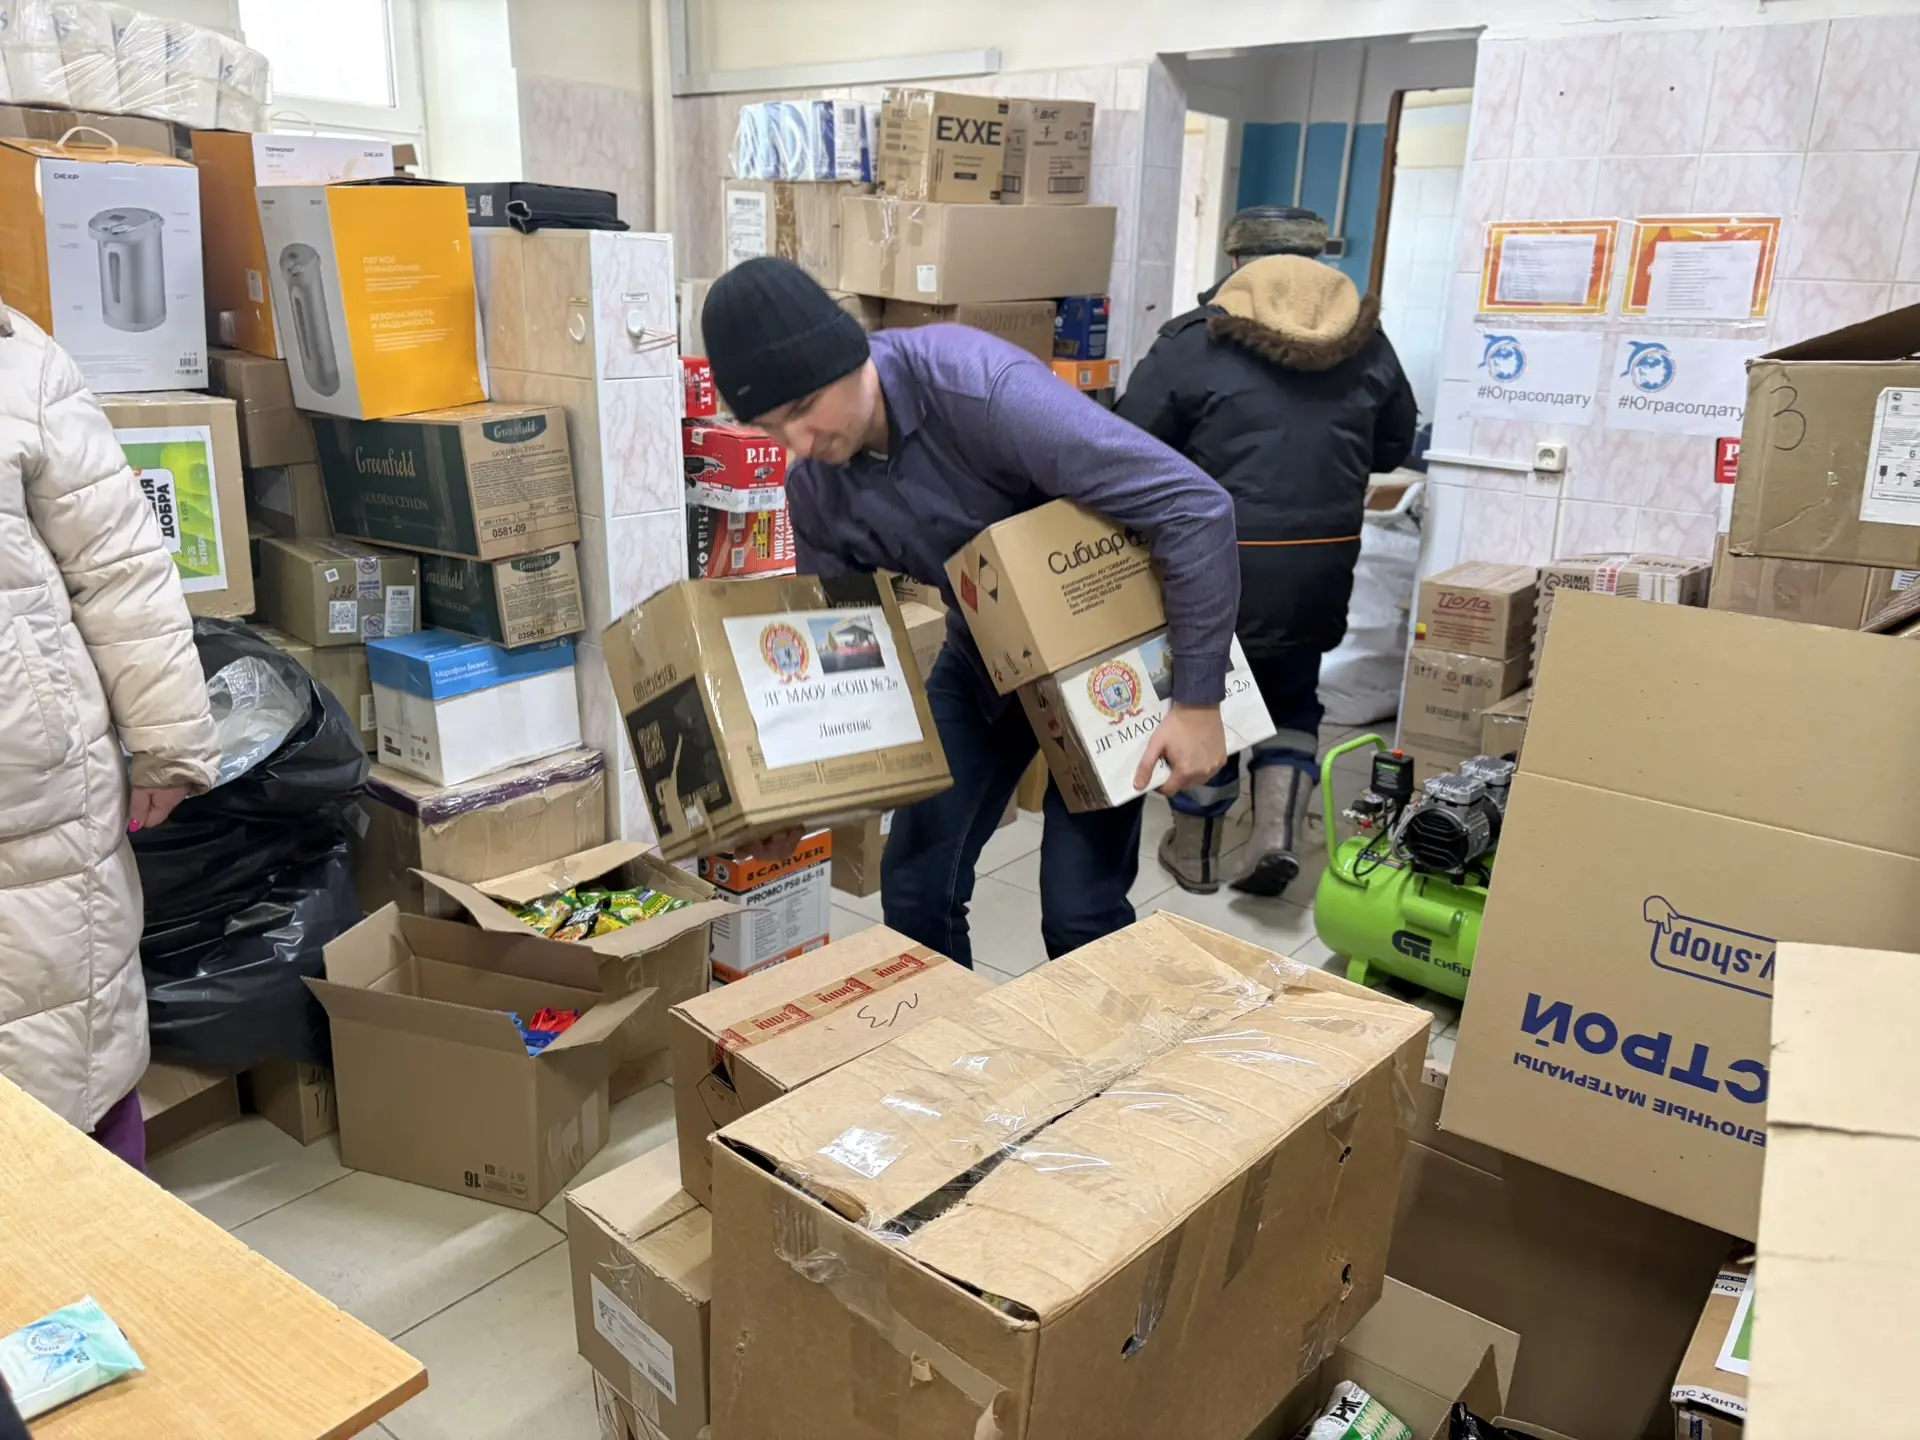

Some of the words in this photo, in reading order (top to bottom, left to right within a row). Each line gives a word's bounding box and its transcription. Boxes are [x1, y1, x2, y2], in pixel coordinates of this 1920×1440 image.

[936, 116, 1003, 146] EXXE
[699, 366, 711, 409] P.I.T.
[1477, 385, 1591, 409] #Юграсолдату
[1618, 395, 1744, 421] #Юграсолдату
[1770, 385, 1806, 451] 3
[493, 420, 536, 438] Greenfield
[355, 446, 416, 479] Greenfield
[746, 447, 782, 464] P.I.T.
[156, 483, 176, 539] ДОБРА
[492, 523, 526, 538] 0581-09
[1048, 533, 1124, 575] Сибиар
[1562, 574, 1590, 584] SIMA
[435, 665, 466, 678] Марафон
[764, 690, 782, 708] ЛГ
[786, 684, 826, 703] МАОУ
[831, 680, 868, 699] «СОШ
[886, 675, 898, 691] 2»
[1232, 679, 1251, 693] 2»
[819, 718, 873, 739] Лангепас
[1095, 733, 1116, 754] ЛГ
[1117, 712, 1163, 744] МАОУ
[756, 845, 825, 877] CARVER
[746, 886, 783, 906] PROMO
[1669, 927, 1775, 981] y.shop
[876, 960, 909, 978] KUDO
[1434, 957, 1471, 977] сибр
[819, 983, 852, 1004] KUDO
[755, 1010, 788, 1030] KUDO
[1520, 992, 1770, 1104] СТРОЙ
[1513, 1052, 1647, 1108] МАТЕРИАЛЫ
[1652, 1098, 1767, 1148] ЕЛОЧНЫЕ
[464, 1170, 481, 1188] 16
[1700, 1391, 1748, 1413] Ханты
